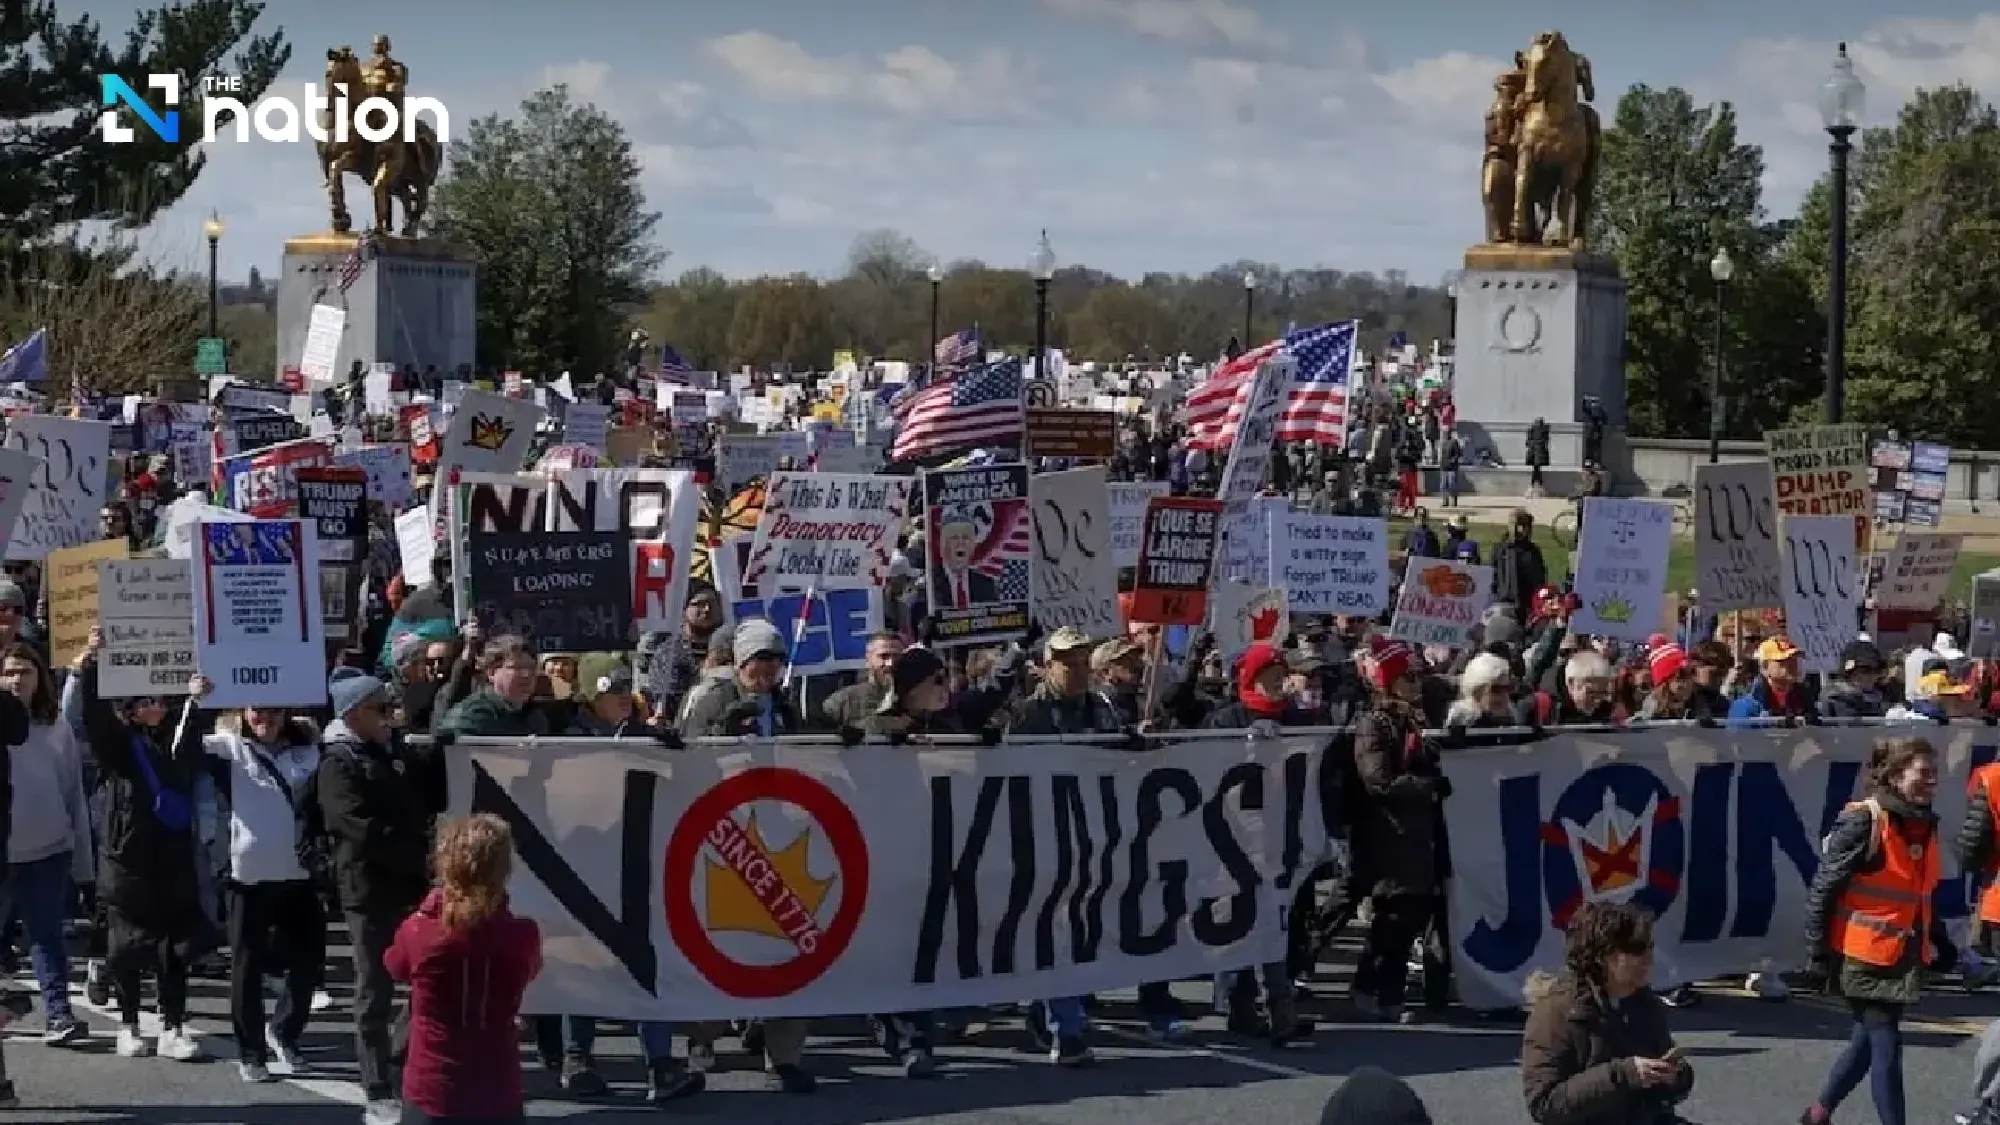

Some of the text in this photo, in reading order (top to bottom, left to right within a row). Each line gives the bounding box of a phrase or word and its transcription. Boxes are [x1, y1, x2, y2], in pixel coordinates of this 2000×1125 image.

[943, 470, 1011, 488] WAKE UP
[1777, 471, 1852, 497] DUMP
[302, 482, 363, 500] TRUMP
[789, 480, 824, 508] This
[848, 482, 889, 509] What
[308, 500, 358, 518] MUST
[320, 519, 346, 535] GO
[768, 514, 887, 549] Democracy
[1195, 511, 1213, 532] SE
[1285, 523, 1375, 542] Tried to make
[1148, 533, 1212, 559] LARGUE
[1304, 548, 1338, 563] witty
[1148, 559, 1206, 584] TRUMP
[1331, 568, 1378, 585] TRUMP
[513, 573, 595, 592] LOADING
[1288, 588, 1332, 604] CAN'T
[232, 666, 282, 685] IDIOT
[707, 818, 776, 895] SINCE
[1461, 760, 1863, 973] JOIN
[471, 758, 869, 998] NO
[914, 752, 1308, 983] KINGS!
[771, 888, 819, 955] 1776
